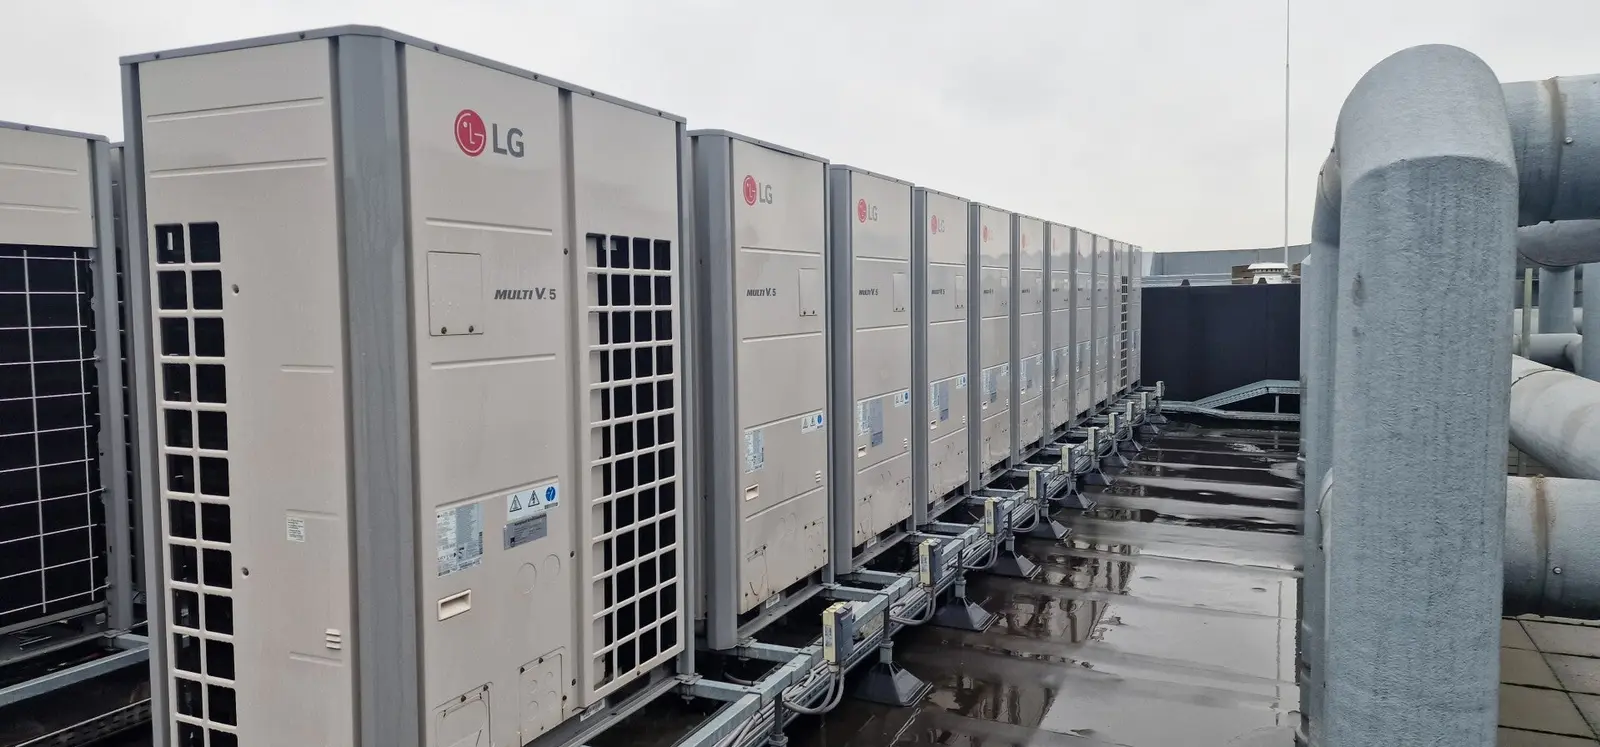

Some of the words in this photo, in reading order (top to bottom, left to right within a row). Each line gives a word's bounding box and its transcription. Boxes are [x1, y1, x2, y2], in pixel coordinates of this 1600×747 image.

[492, 123, 524, 158] LG
[759, 182, 772, 204] LG
[868, 204, 878, 221] LG
[494, 289, 533, 300] MULTI
[549, 288, 556, 300] 5
